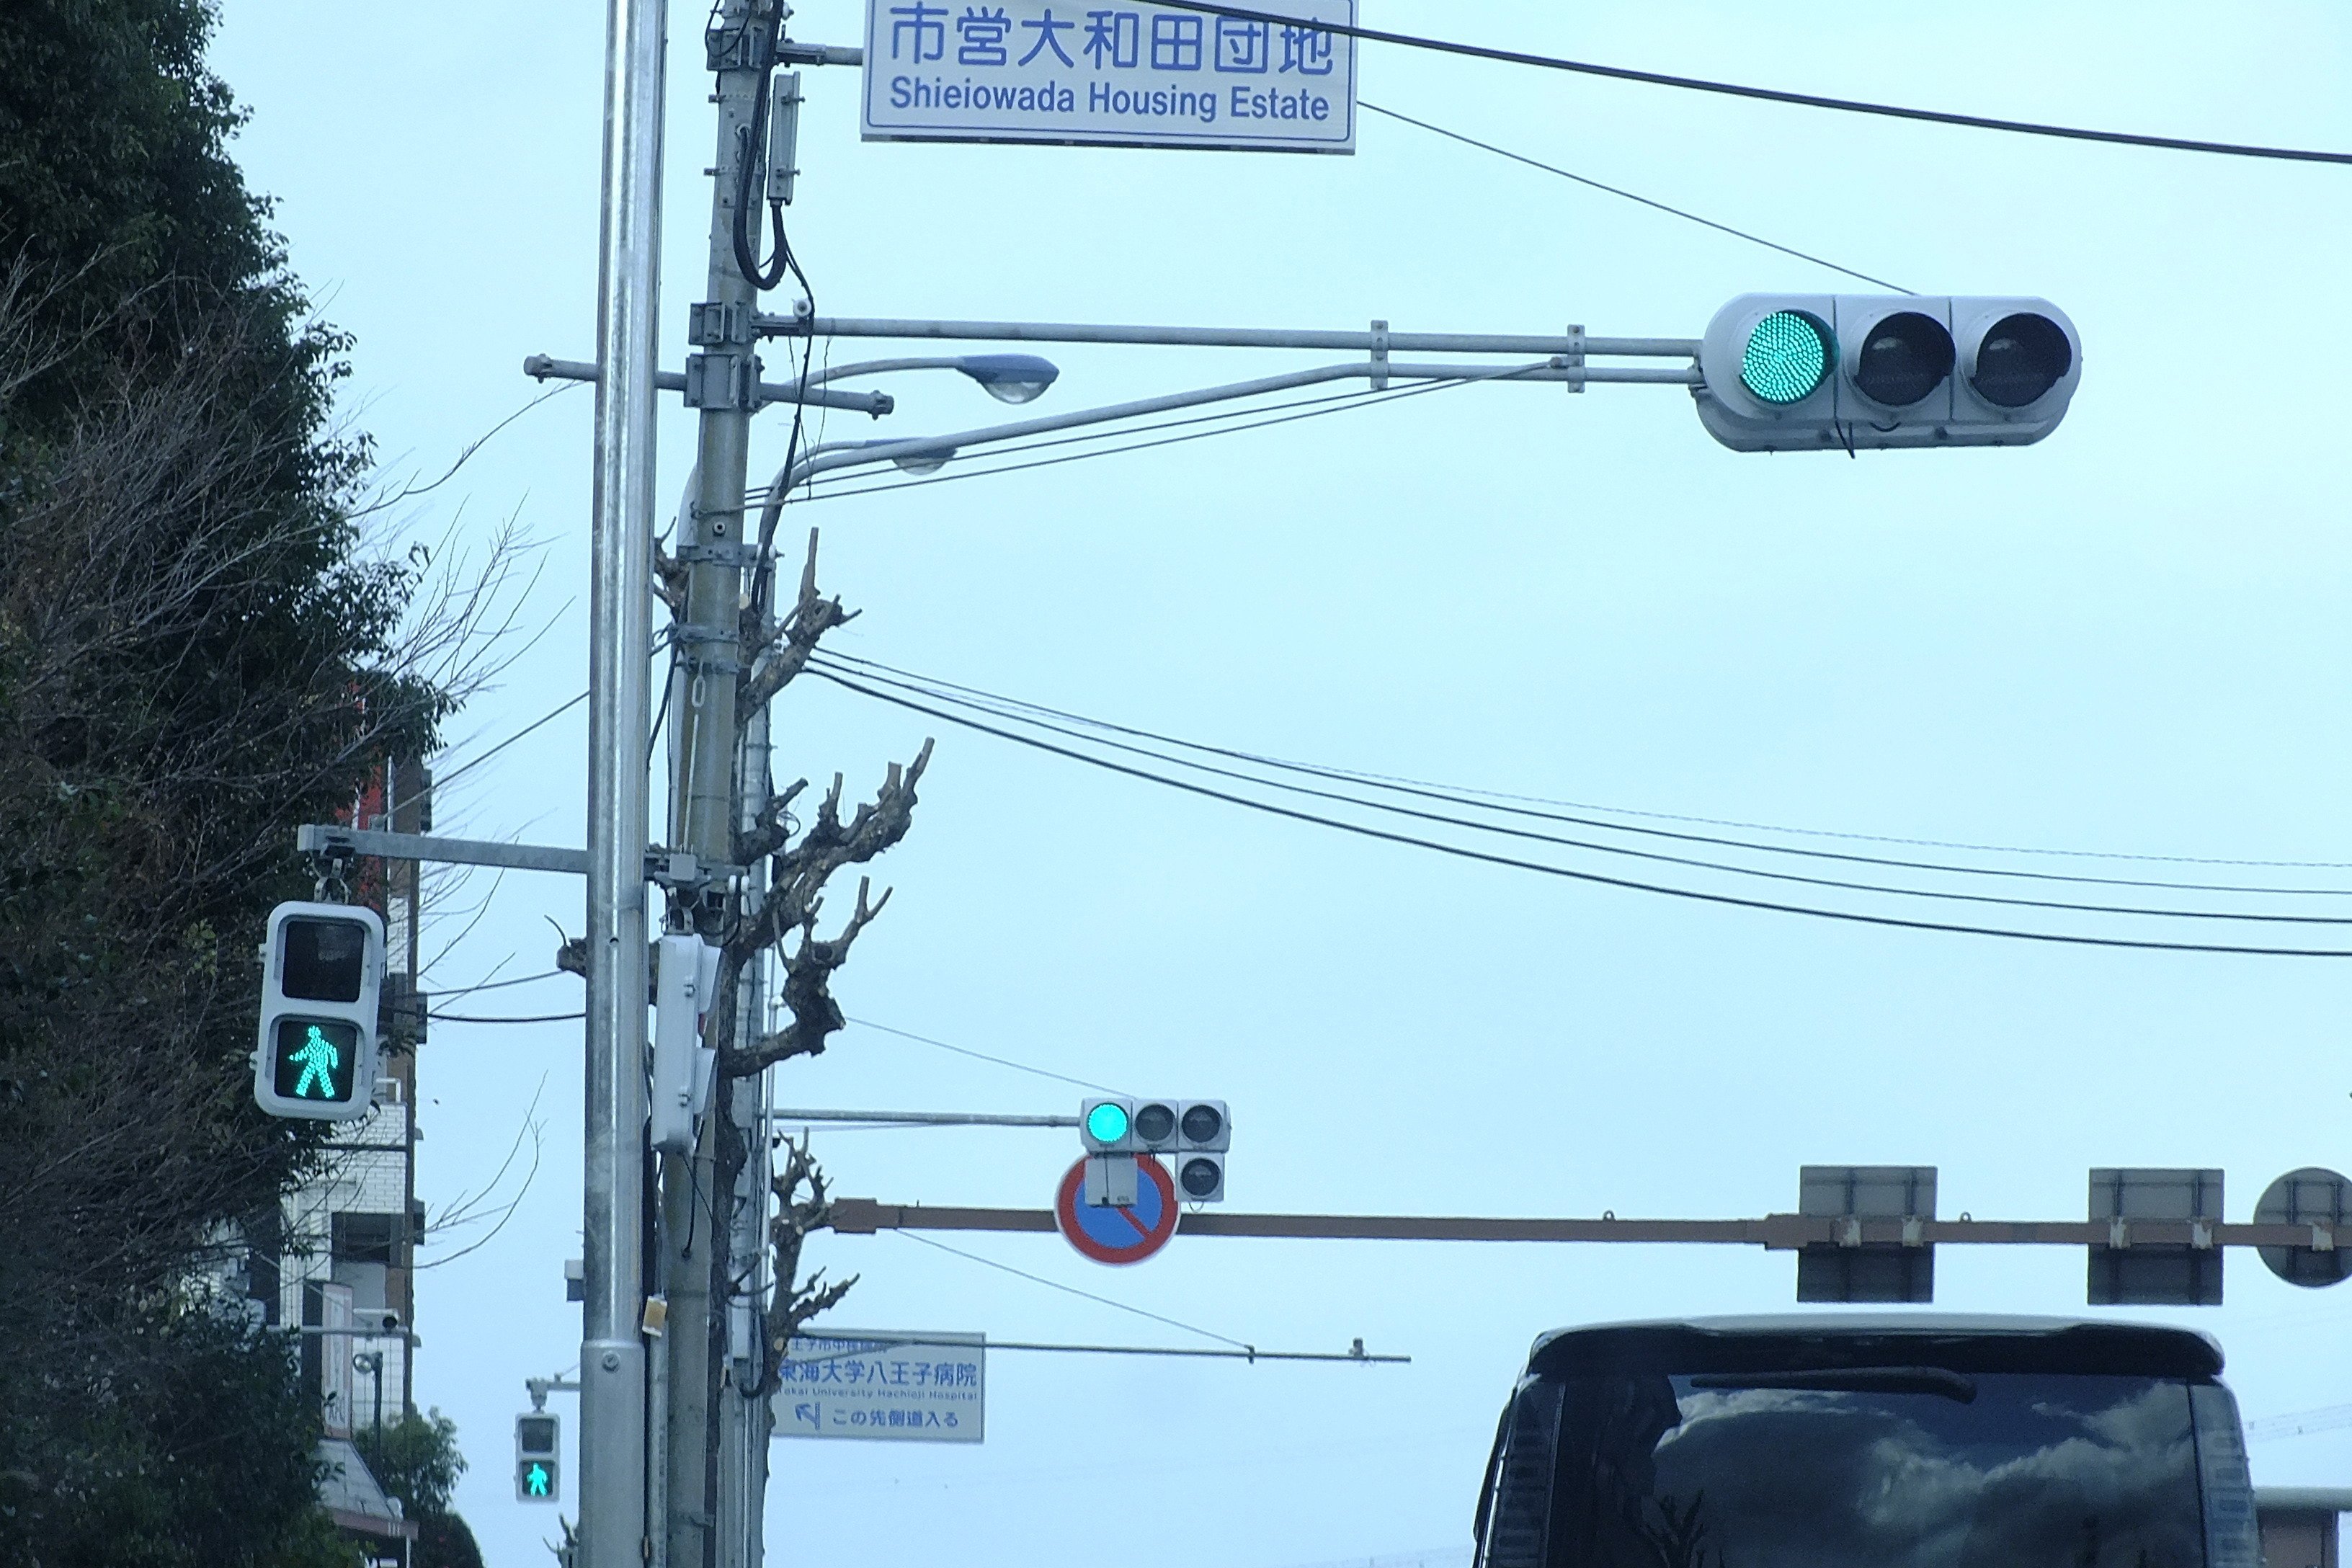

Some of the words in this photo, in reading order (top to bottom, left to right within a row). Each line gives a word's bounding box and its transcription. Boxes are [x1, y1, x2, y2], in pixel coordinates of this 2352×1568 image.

[890, 1, 1333, 75] 市営大和田団地
[890, 76, 1075, 113] Shieiowada
[1089, 82, 1217, 123] Housing
[1231, 86, 1329, 121] Estate
[778, 1358, 977, 1387] 東海大学八王子病院
[813, 1388, 873, 1399] University
[930, 1391, 977, 1401] Hospital
[833, 1409, 958, 1428] この先側道入る
